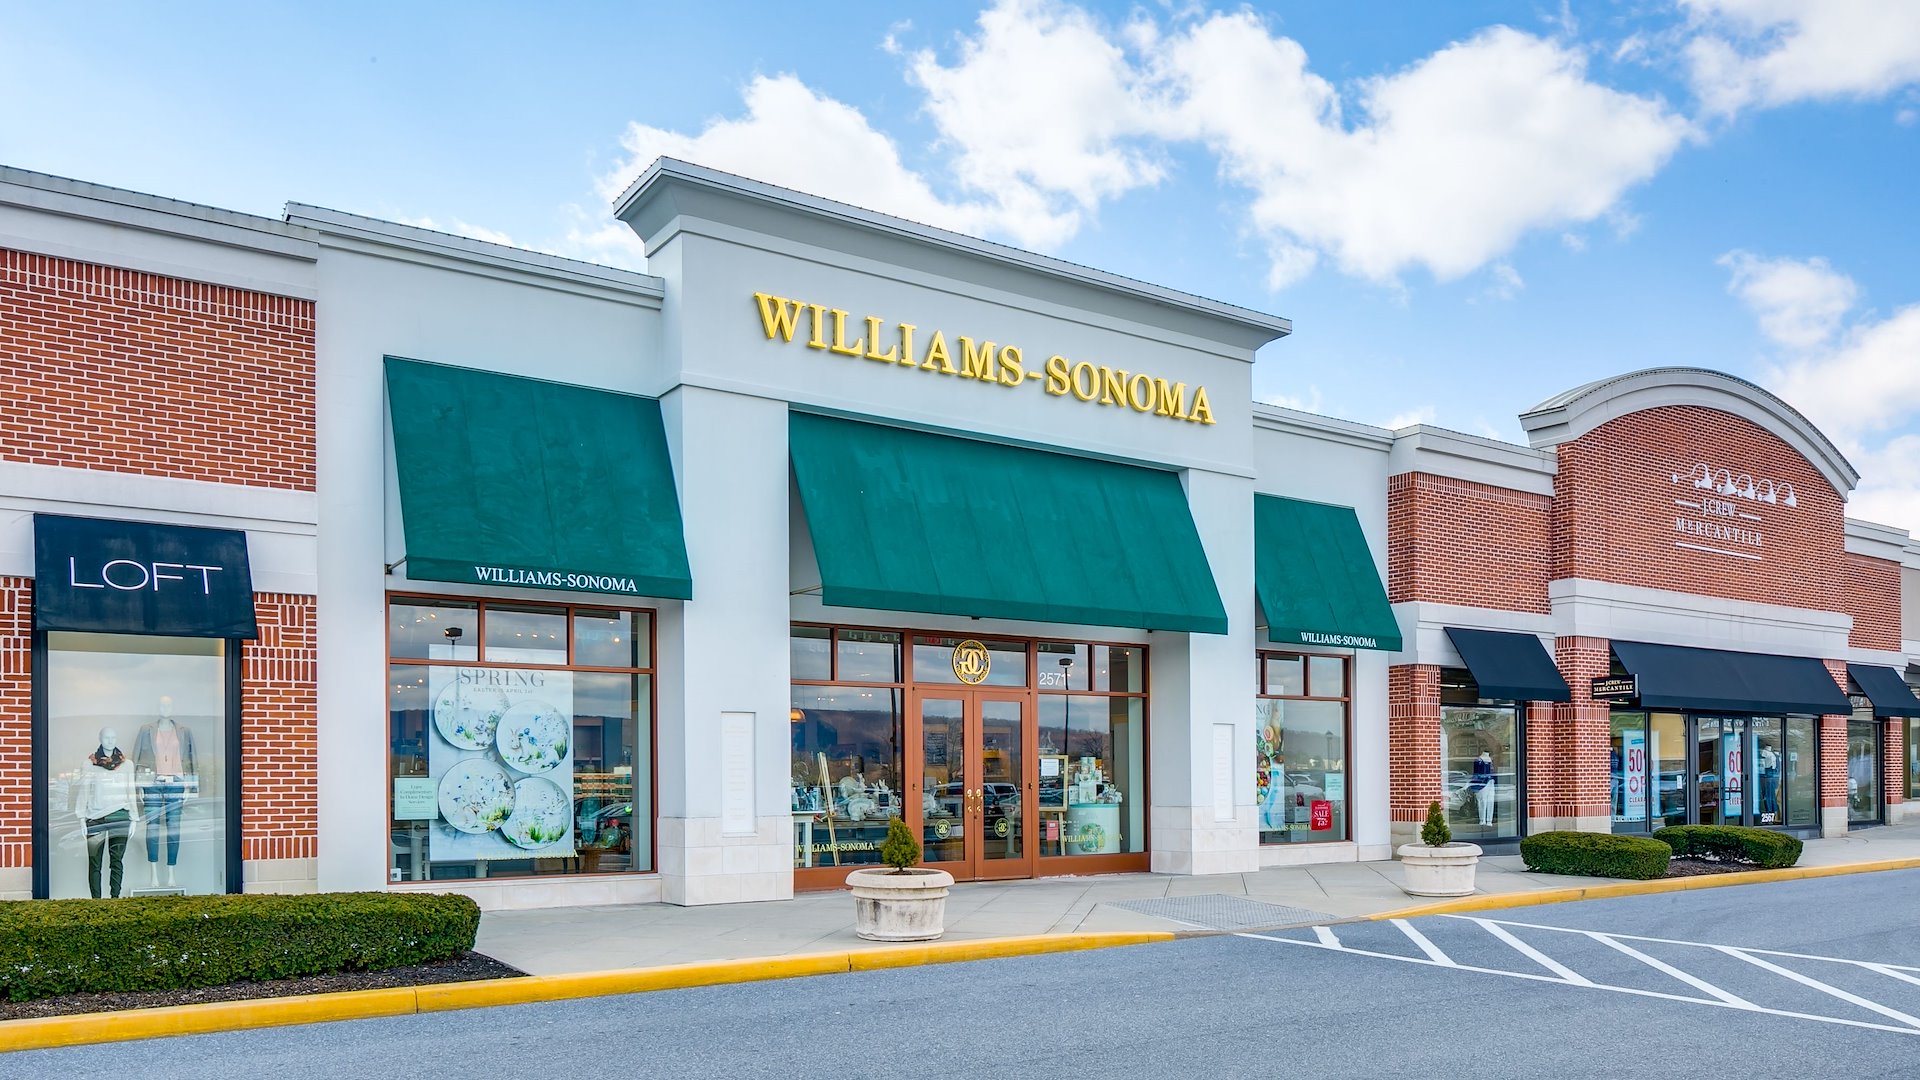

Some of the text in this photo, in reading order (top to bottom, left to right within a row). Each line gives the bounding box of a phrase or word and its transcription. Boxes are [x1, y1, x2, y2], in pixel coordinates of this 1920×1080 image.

[753, 291, 1217, 425] WILLIAMS-SONOMA
[1702, 499, 1736, 517] J.CREW
[1675, 517, 1762, 546] MERCANTILE
[69, 556, 223, 595] LOFT
[475, 566, 638, 592] WILLIAMS-SONOMA
[1300, 631, 1377, 648] WILLIAMS-SONOMA
[460, 668, 545, 688] SPRING
[1039, 672, 1067, 686] 2571
[1593, 684, 1633, 693] MERCANTILE
[1628, 749, 1654, 772] 50
[1314, 810, 1329, 818] SALE
[1761, 813, 1775, 823] 2567
[795, 842, 875, 853] WLIAMS-SONOMA
